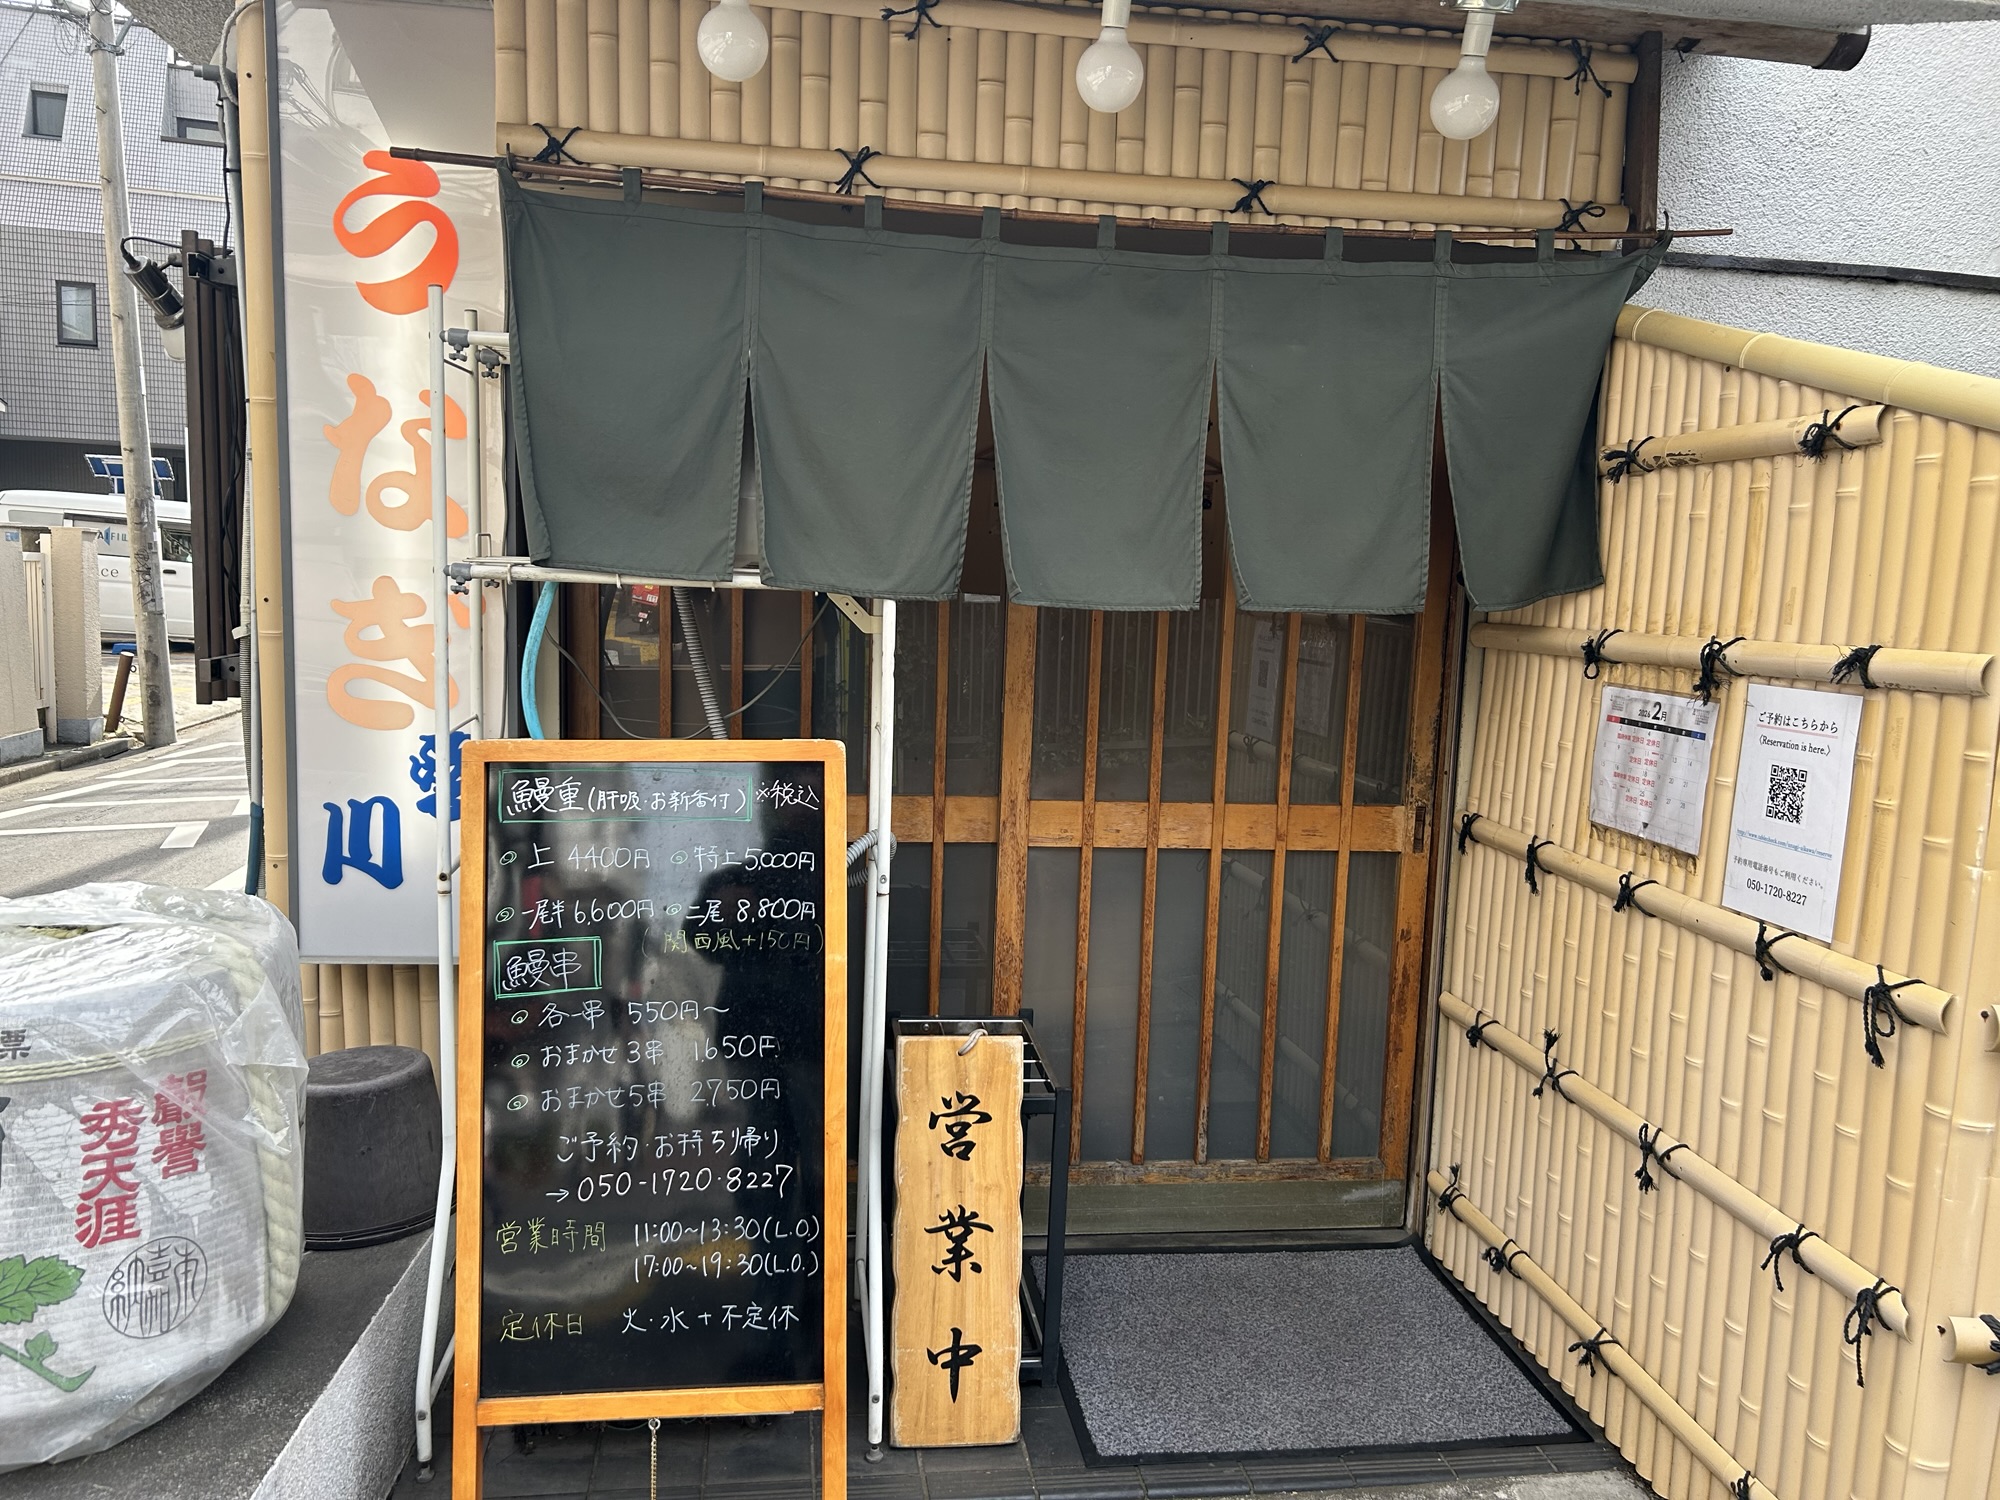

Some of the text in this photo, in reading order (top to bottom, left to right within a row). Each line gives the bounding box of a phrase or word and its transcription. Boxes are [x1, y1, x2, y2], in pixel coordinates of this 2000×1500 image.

[323, 150, 485, 730] うなぎ
[1759, 711, 1838, 734] ご予約はこちらから
[1801, 742, 1807, 752] is
[527, 842, 555, 869] 上
[1746, 877, 1807, 906] 050-1720-8227
[685, 899, 724, 927] 二尾
[502, 947, 582, 990] 鰻串
[537, 1000, 605, 1030] 各一串
[75, 1097, 147, 1249] 秀天涯
[496, 1217, 606, 1254] 営業時間
[923, 1090, 994, 1403] 営業中
[500, 1308, 584, 1343] 定休日
[721, 1301, 800, 1331] 不定休
